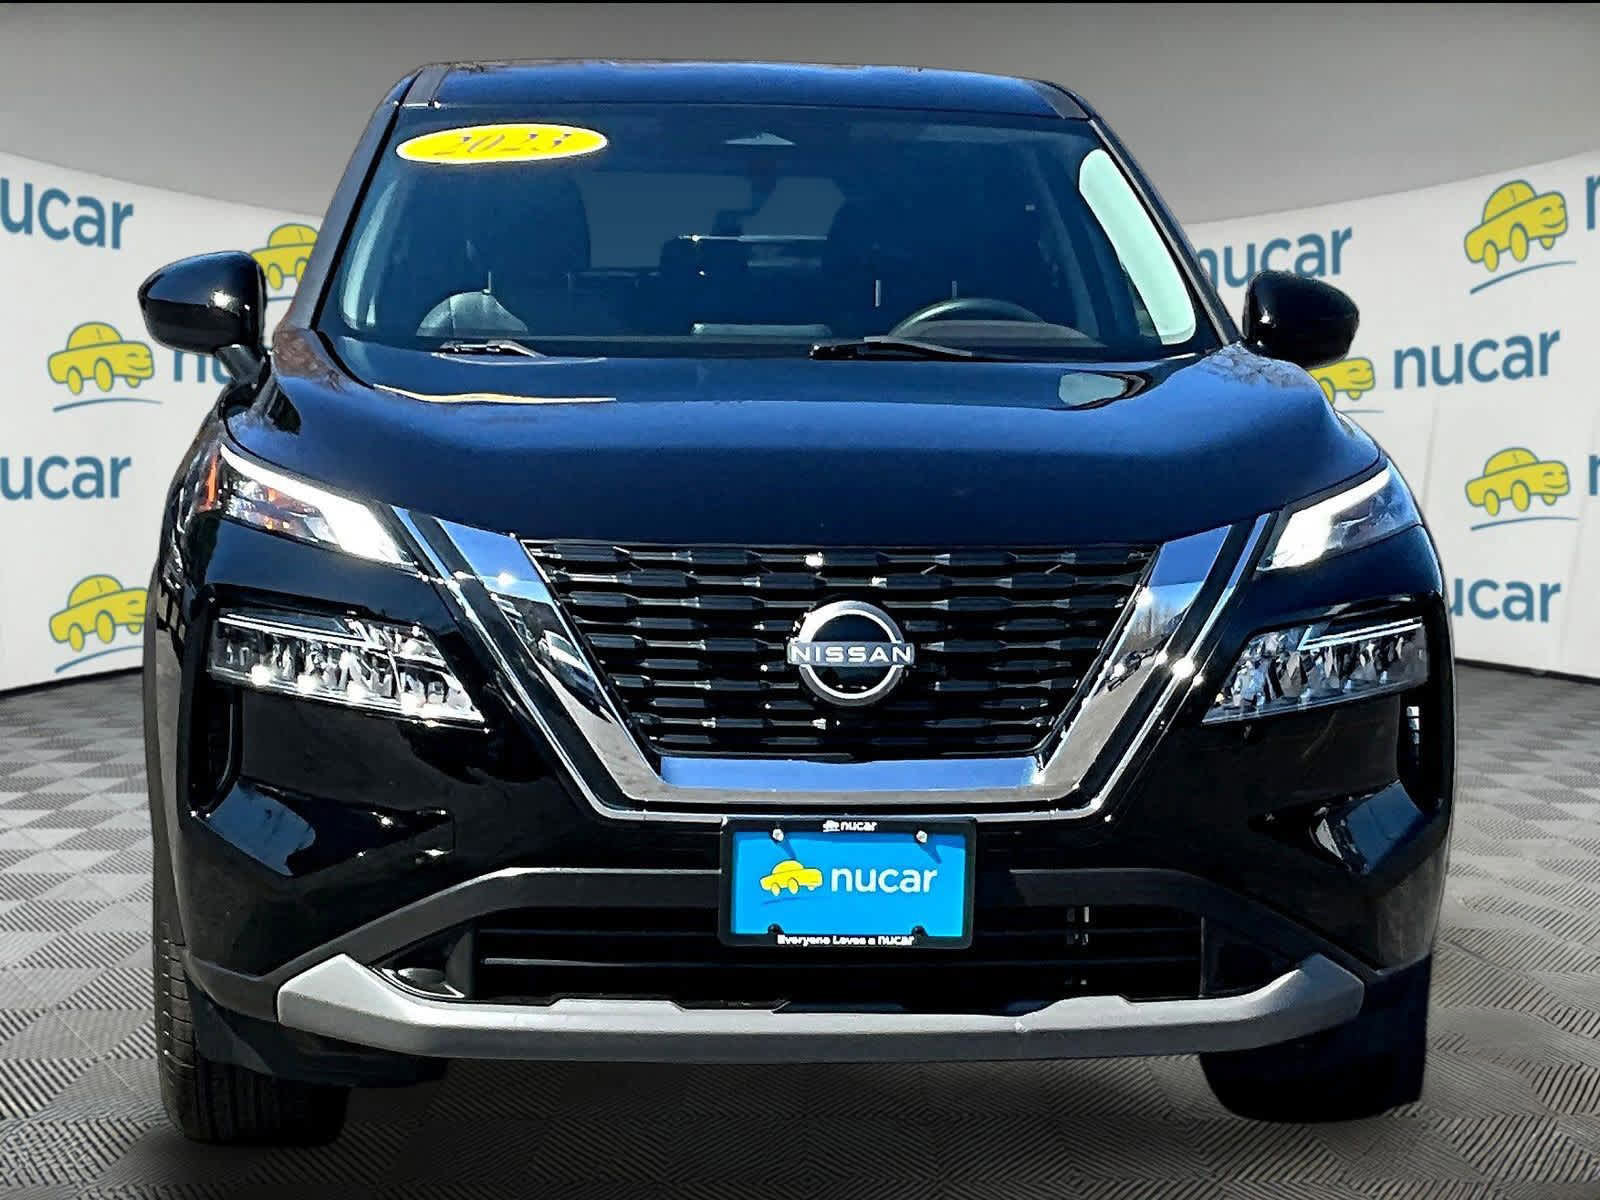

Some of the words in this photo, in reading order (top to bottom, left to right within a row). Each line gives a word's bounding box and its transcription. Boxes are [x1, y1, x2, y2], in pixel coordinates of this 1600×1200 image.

[1394, 329, 1561, 389] nucar
[790, 645, 912, 664] NISSAN
[840, 820, 878, 832] nucar
[831, 867, 938, 893] nucar
[777, 934, 831, 947] Everyone
[832, 935, 867, 945] Loves
[868, 937, 876, 945] a
[877, 935, 915, 946] nucar
